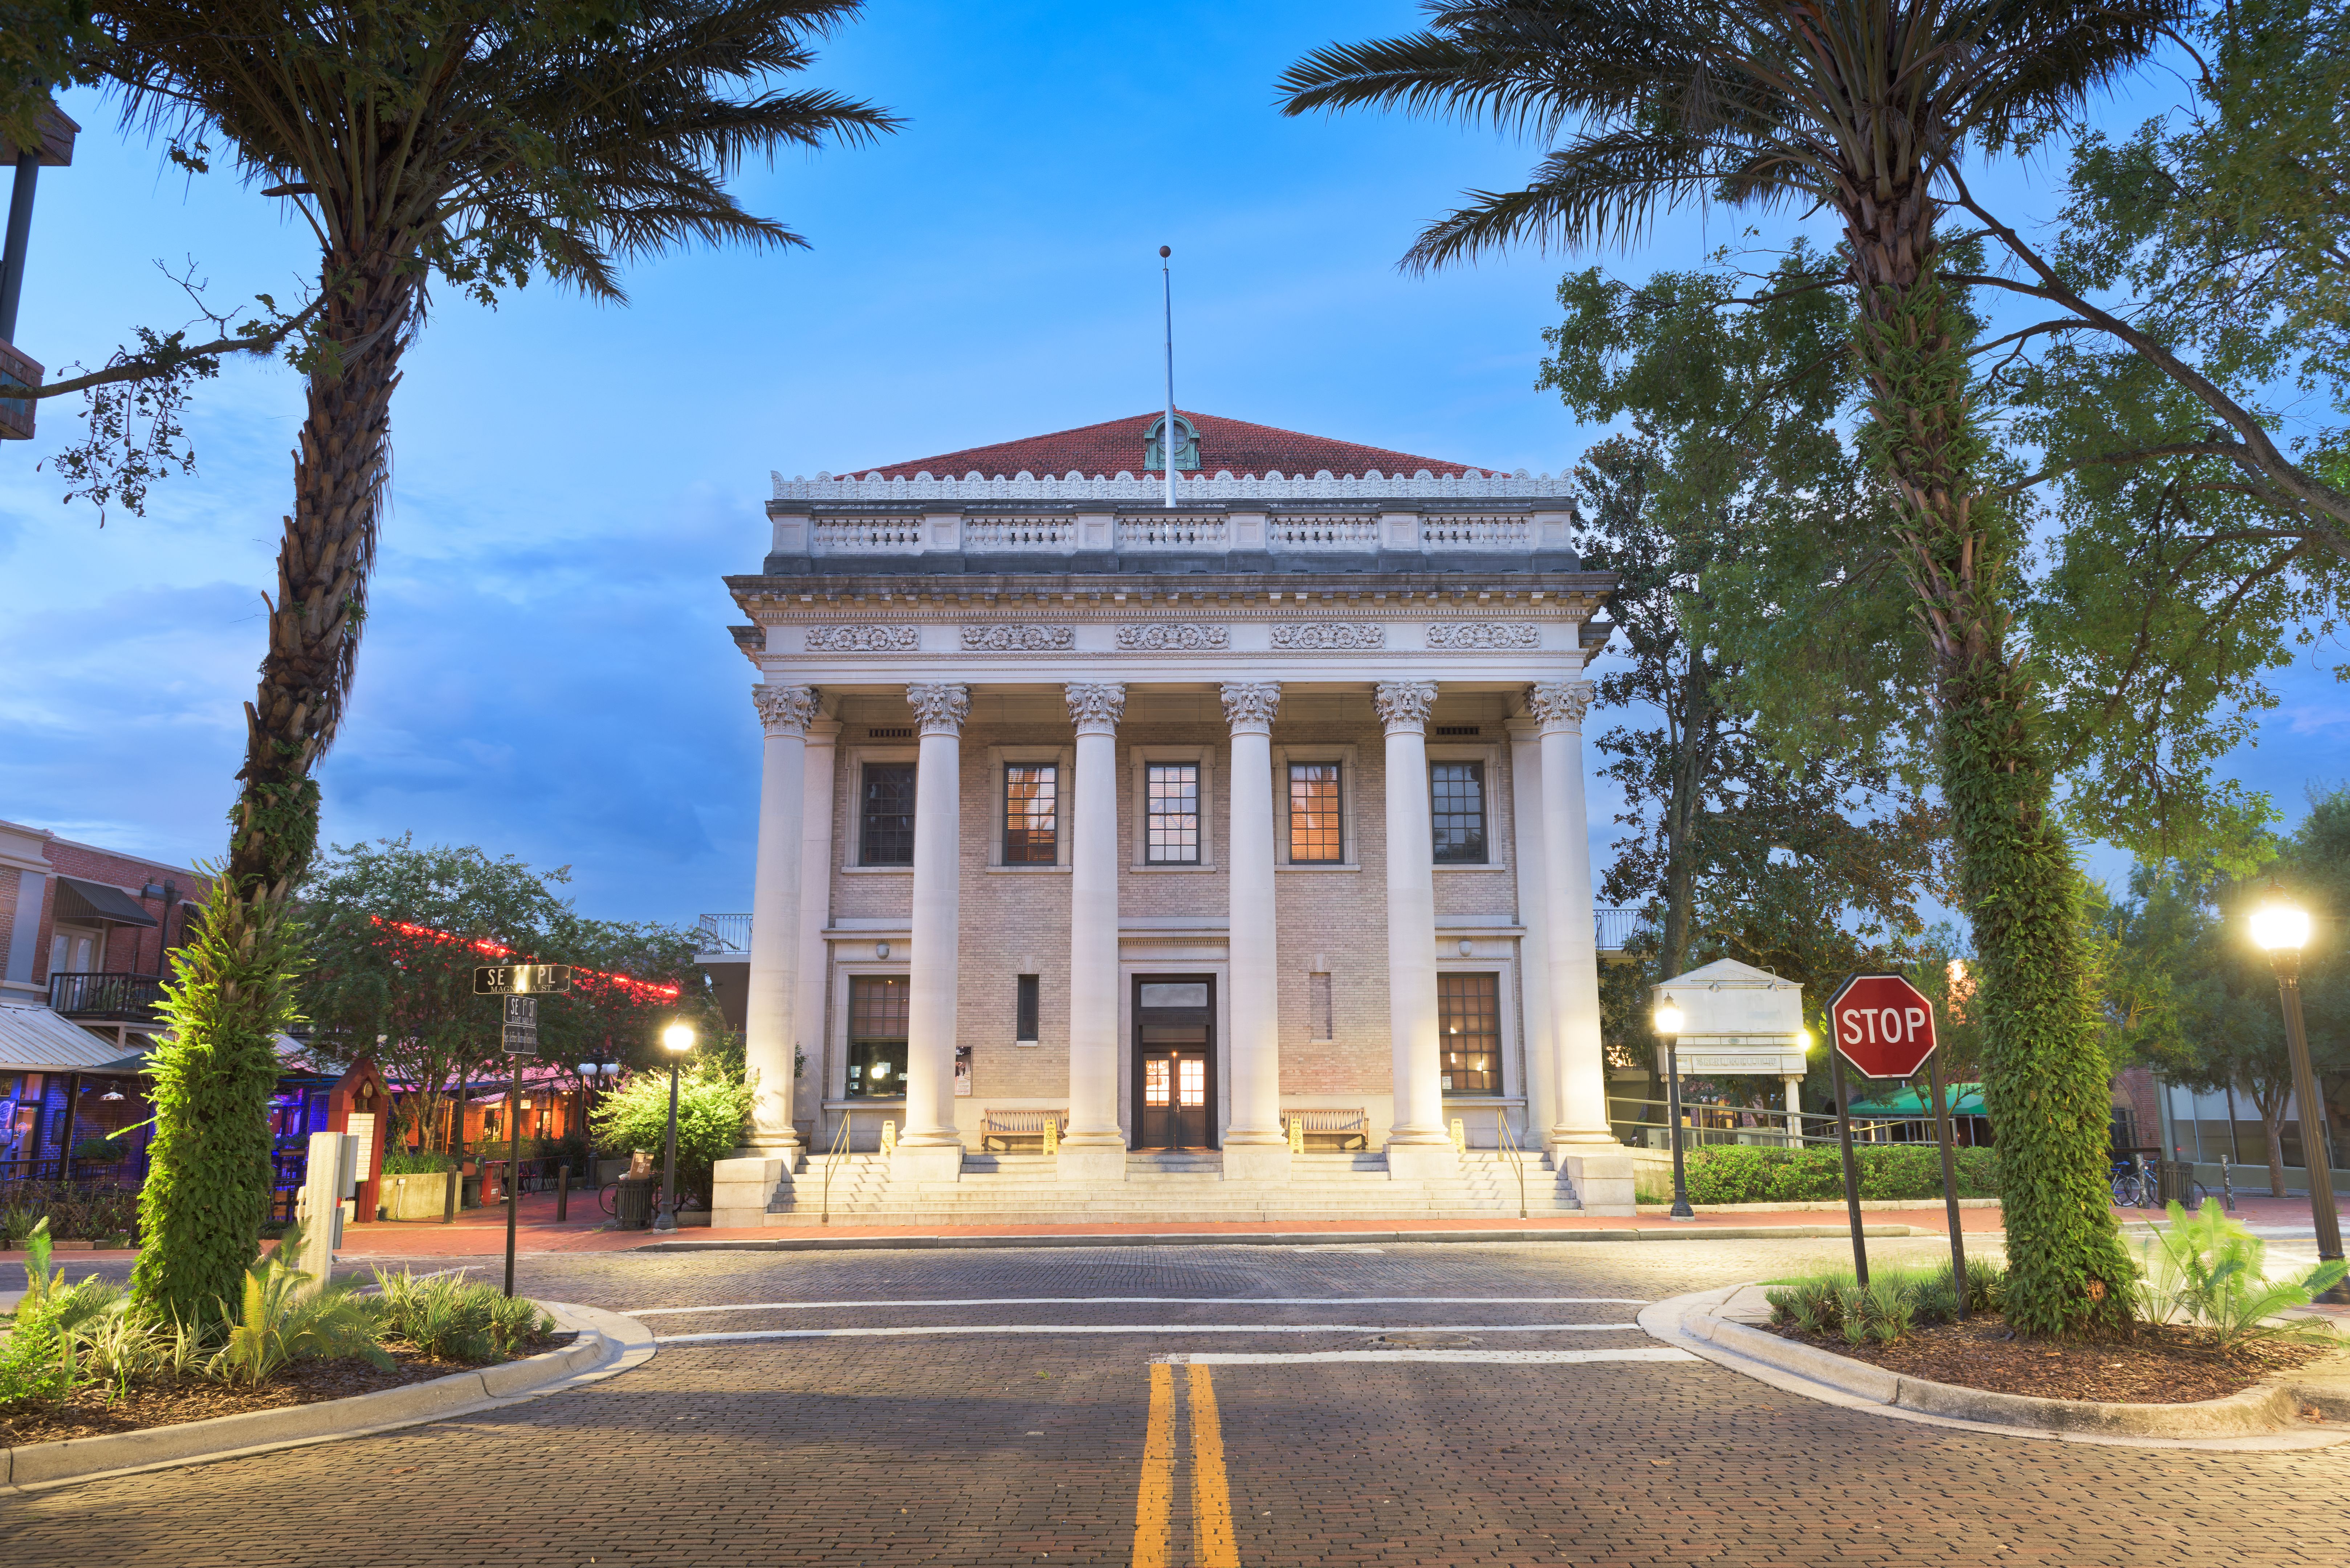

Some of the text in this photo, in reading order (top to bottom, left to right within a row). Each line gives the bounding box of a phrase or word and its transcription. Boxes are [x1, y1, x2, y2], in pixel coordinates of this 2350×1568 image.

[488, 969, 505, 985] SE
[538, 967, 555, 984] PL
[511, 998, 519, 1015] SE
[529, 1001, 534, 1017] ST
[1842, 1008, 1925, 1044] STOP
